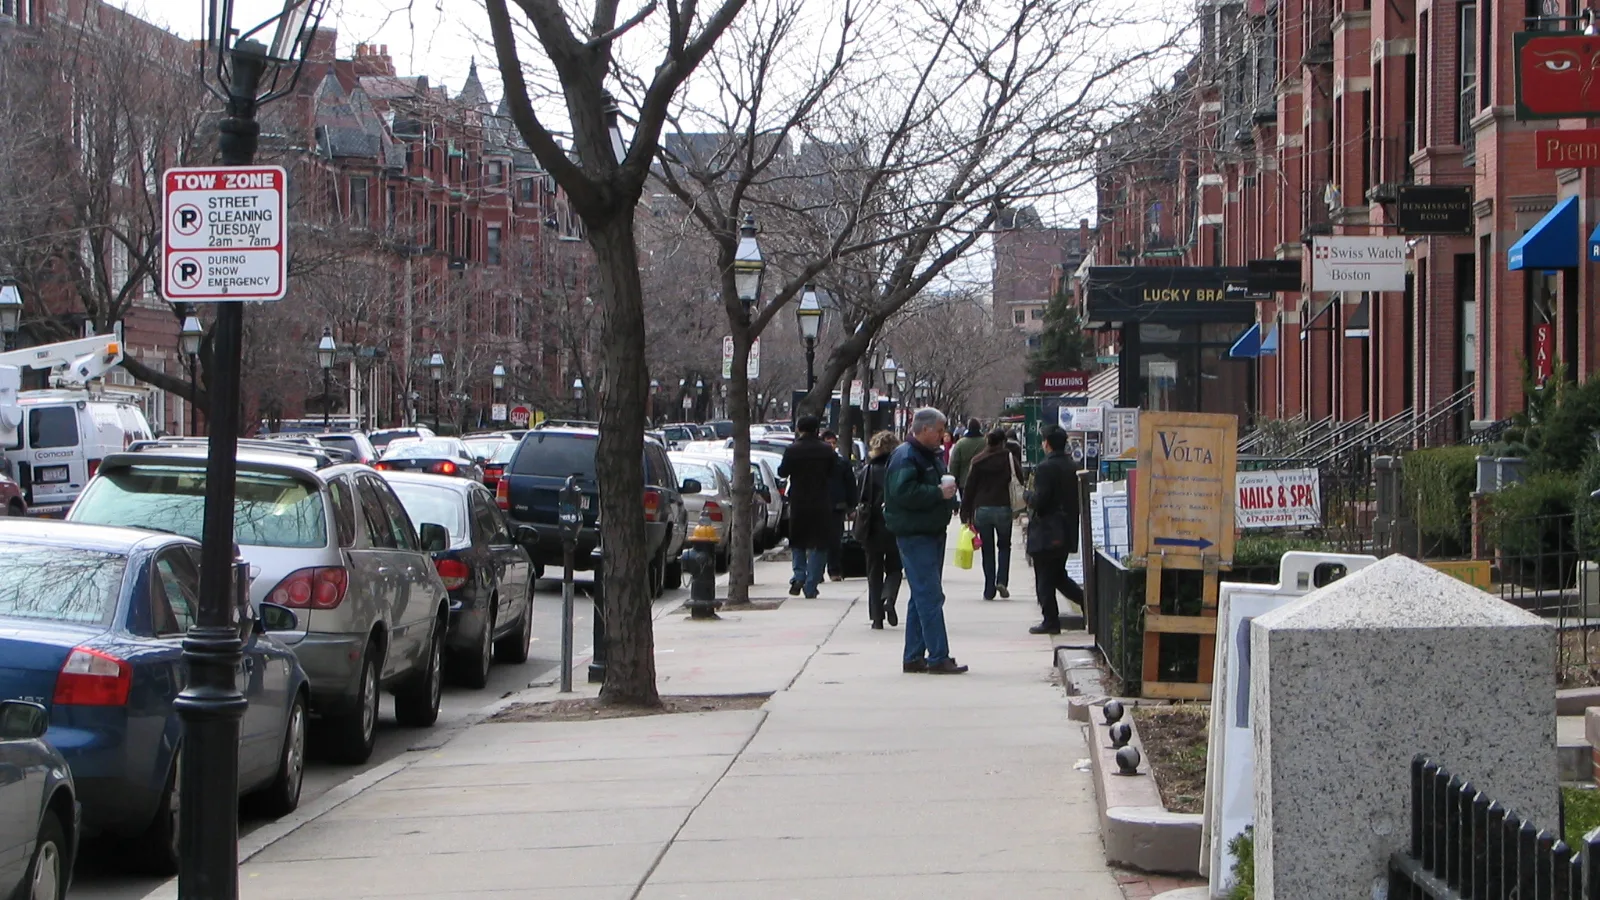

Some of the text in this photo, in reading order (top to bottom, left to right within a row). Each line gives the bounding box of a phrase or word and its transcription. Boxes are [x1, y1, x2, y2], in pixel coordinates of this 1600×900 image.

[174, 173, 274, 189] TOW ZONE
[208, 195, 258, 209] STREET
[1402, 202, 1467, 210] RENAISSANCE
[208, 209, 272, 223] CLEANING
[1420, 213, 1448, 221] ROOM
[209, 223, 261, 236] TUESDAY
[208, 236, 233, 247] 2am
[249, 235, 271, 246] 7am
[1330, 246, 1402, 259] Swiss Watch
[208, 255, 246, 265] DURING
[208, 266, 239, 276] SNOW
[1332, 269, 1371, 281] Boston
[208, 276, 270, 287] EMERGENCY
[1143, 289, 1190, 302] LUCKY
[1044, 376, 1084, 387] ALTERATIONS
[512, 412, 529, 421] STOP
[35, 450, 74, 460] comcast
[1239, 484, 1313, 510] NAILS & SPA
